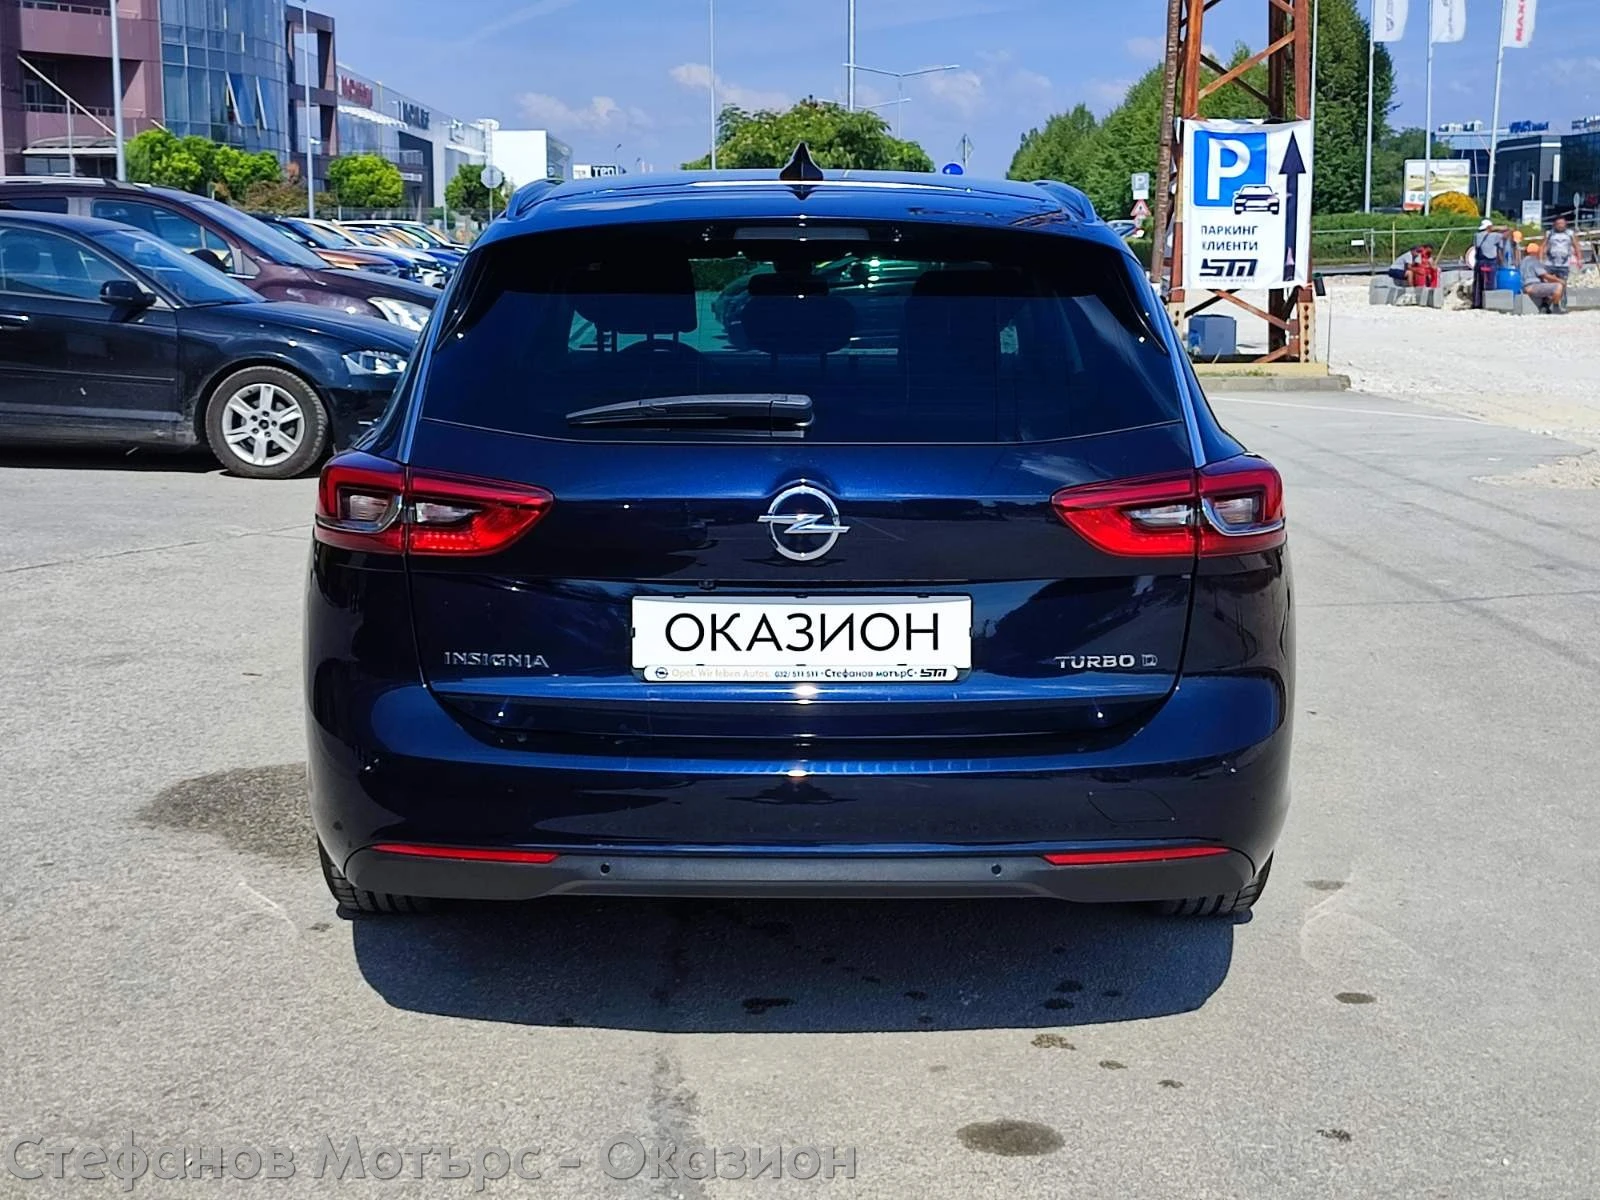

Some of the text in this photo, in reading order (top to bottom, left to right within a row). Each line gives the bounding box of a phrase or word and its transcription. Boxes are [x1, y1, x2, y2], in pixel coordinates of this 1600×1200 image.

[1515, 0, 1525, 42] MAX
[1206, 137, 1251, 201] P
[1200, 225, 1259, 236] ПАРКИНГ
[665, 612, 939, 652] ОКАЗИОН
[444, 651, 550, 669] INSIGNIA
[1055, 654, 1136, 669] TURBO
